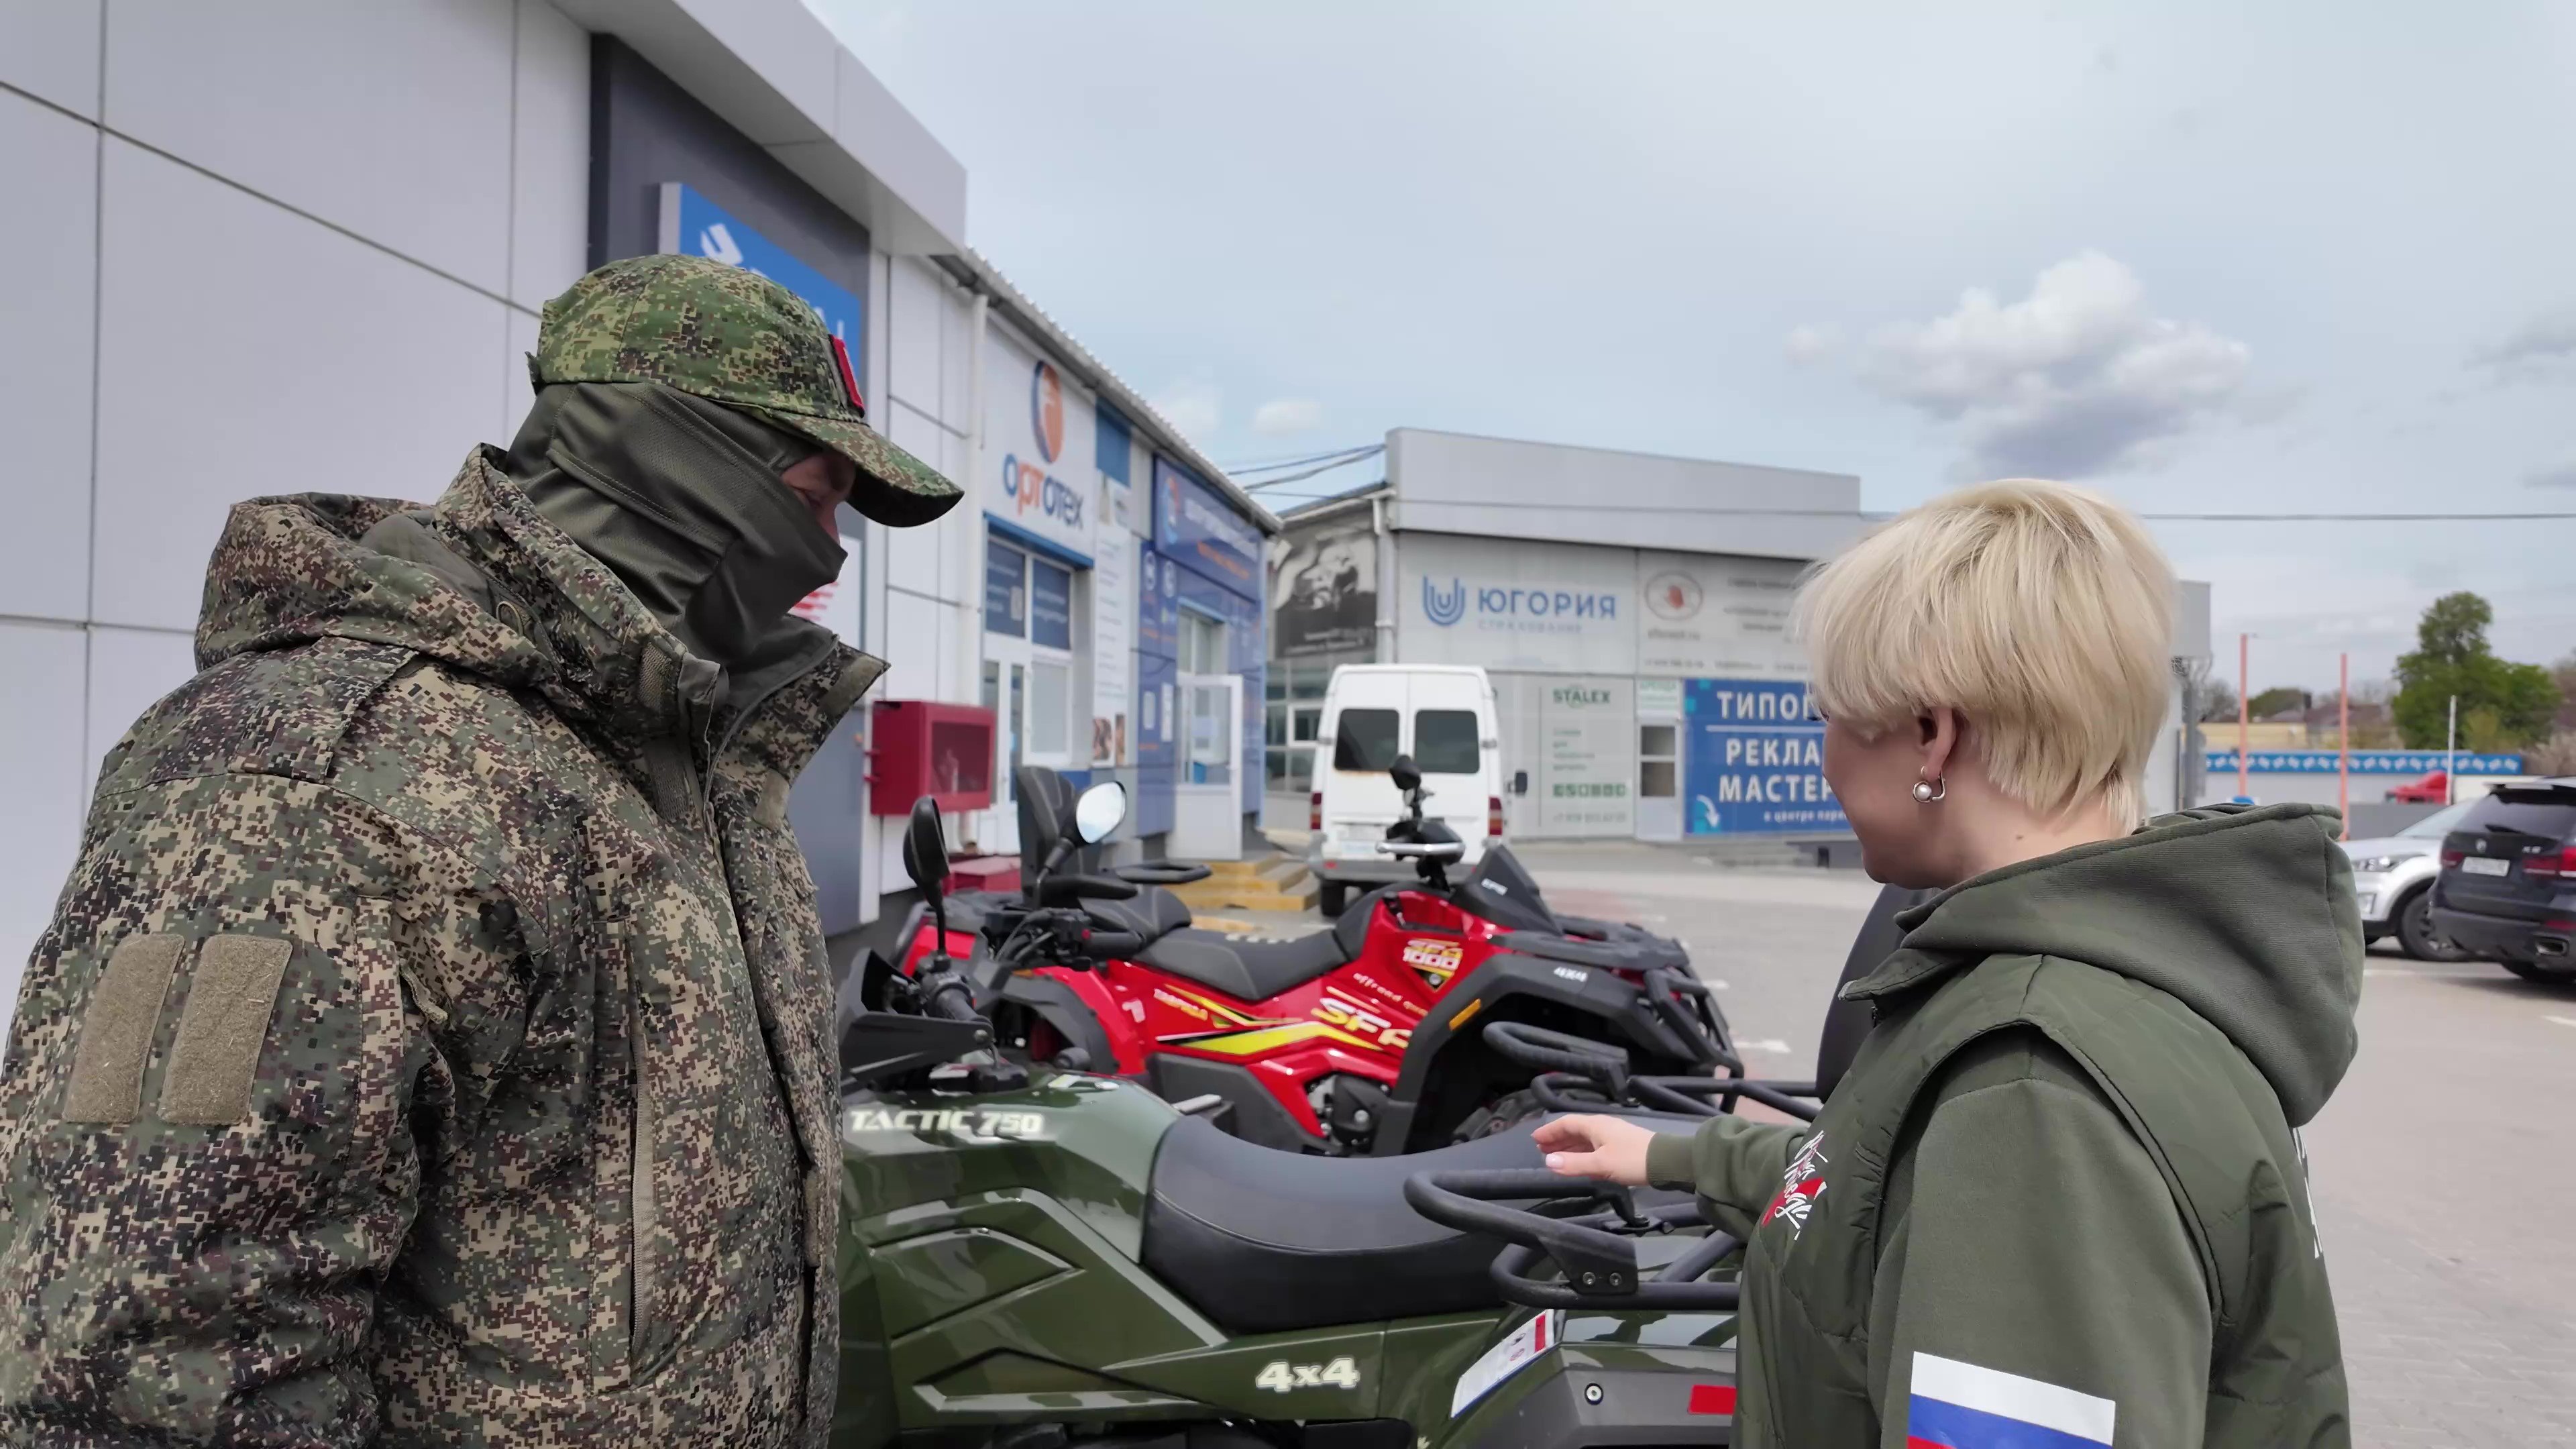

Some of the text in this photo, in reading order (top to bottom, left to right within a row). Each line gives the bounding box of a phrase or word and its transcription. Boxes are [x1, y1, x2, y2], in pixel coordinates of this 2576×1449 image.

[1479, 588, 1616, 619] ЮГОРИЯ
[1552, 687, 1611, 704] STALEX
[1726, 738, 1820, 766] РЕКЛА
[1402, 946, 1460, 971] 1000
[850, 1109, 1044, 1134] TACTIC 750
[1256, 1356, 1360, 1393] 4x4
